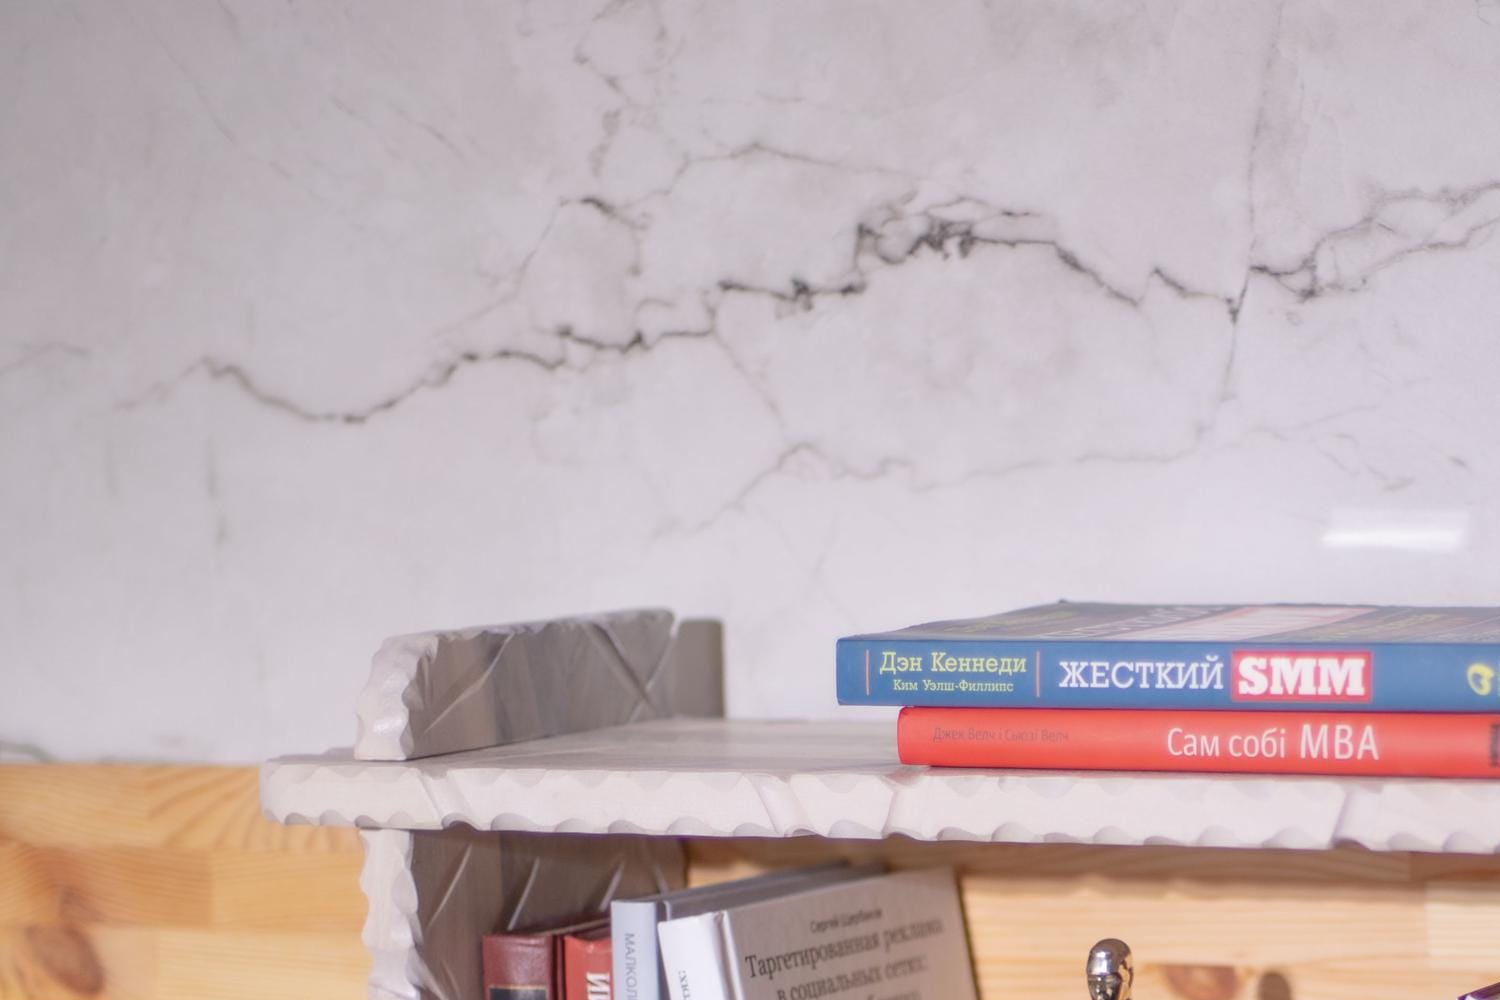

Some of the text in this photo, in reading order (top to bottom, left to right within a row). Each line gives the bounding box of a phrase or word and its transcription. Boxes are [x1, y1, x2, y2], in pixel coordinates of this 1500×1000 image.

[879, 651, 1027, 674] Дэн Кеннеди
[1059, 655, 1365, 696] ЖЕСТКИЙ SMM
[893, 679, 1014, 693] Ким Уэлш-Филлипс
[1167, 727, 1220, 757] Сам
[1228, 726, 1286, 759] собі
[745, 931, 881, 980] Таргетированная
